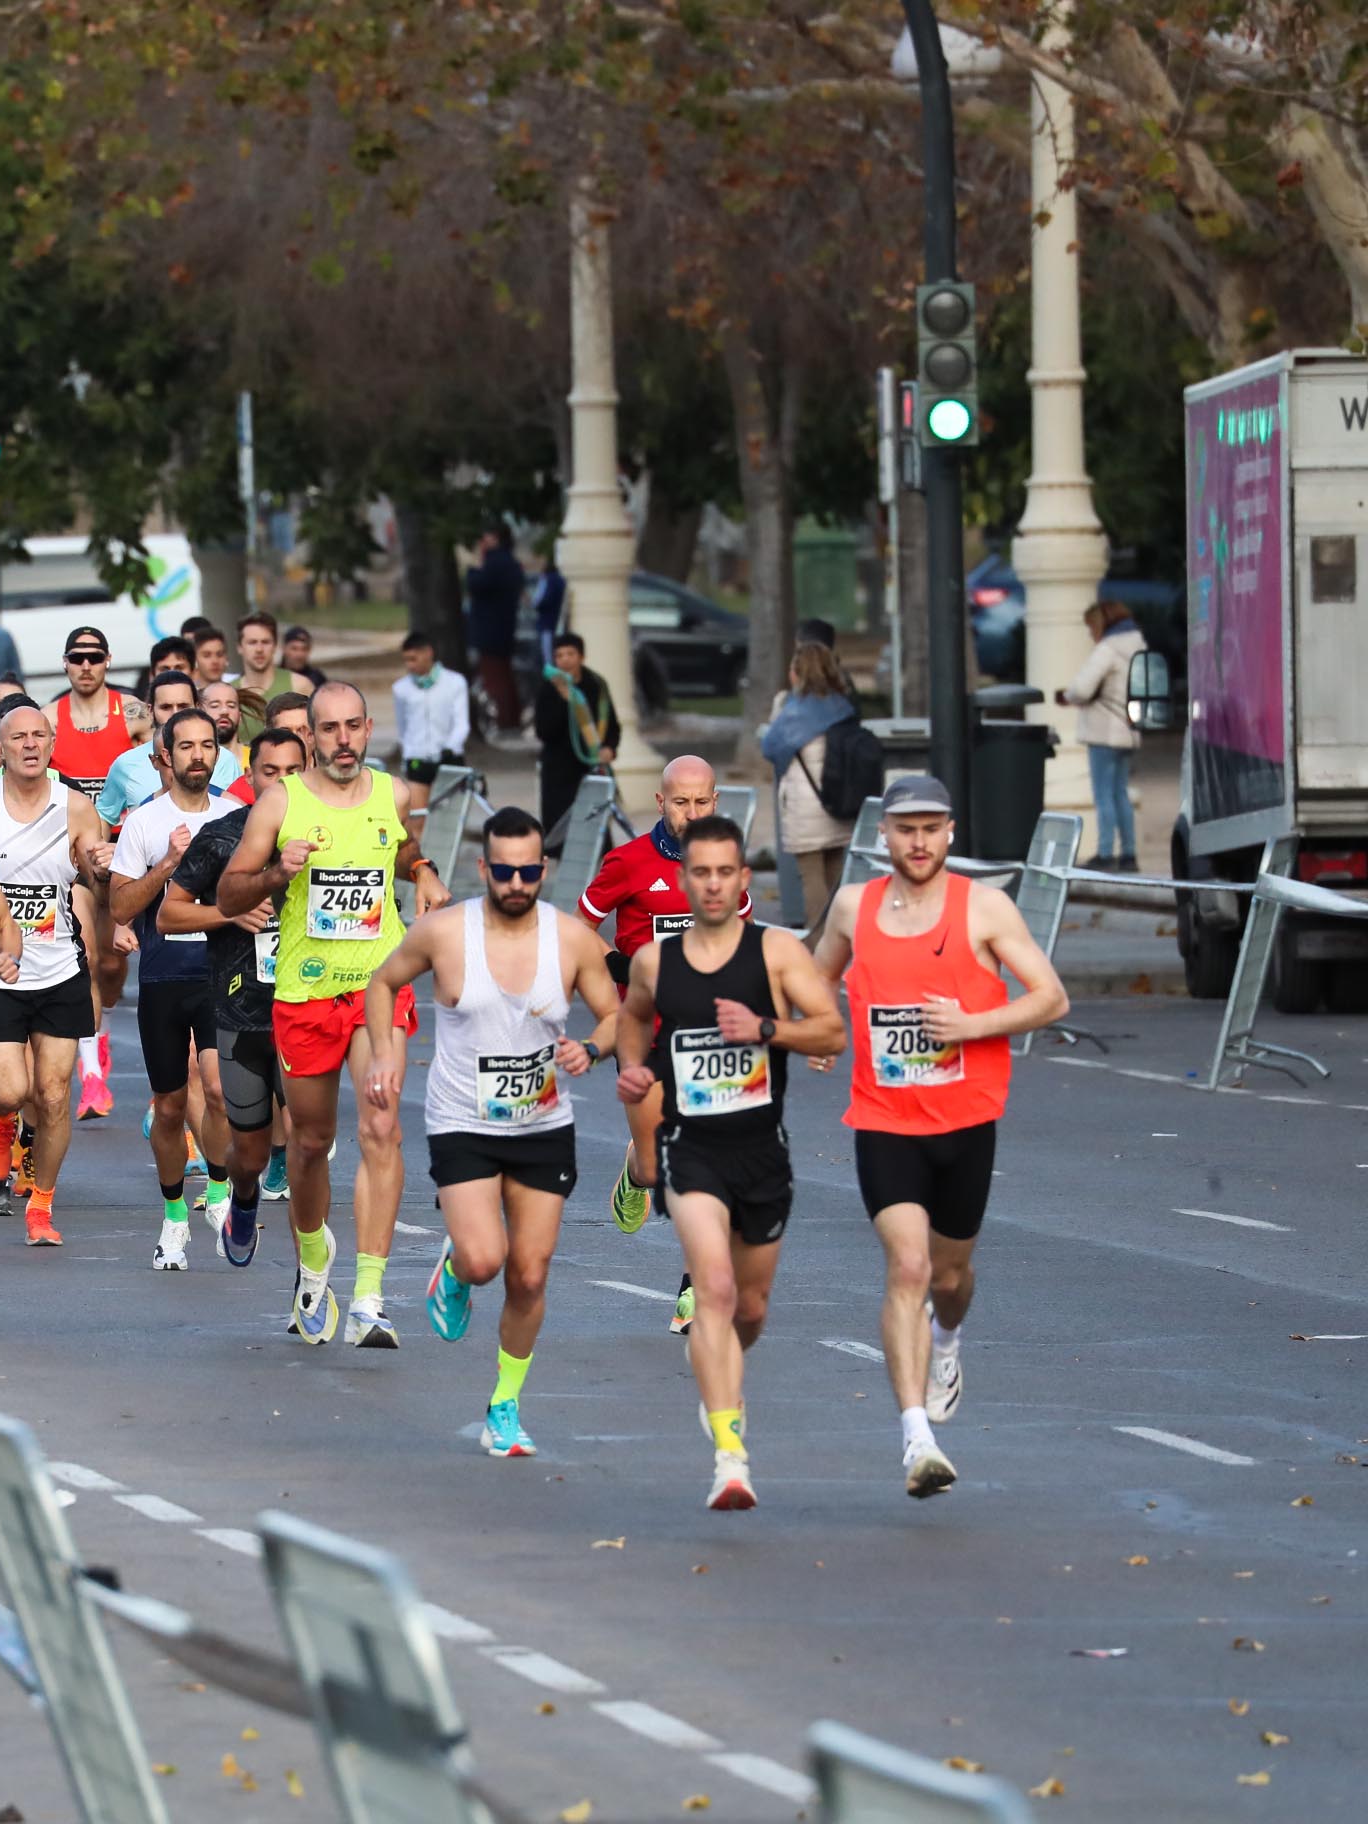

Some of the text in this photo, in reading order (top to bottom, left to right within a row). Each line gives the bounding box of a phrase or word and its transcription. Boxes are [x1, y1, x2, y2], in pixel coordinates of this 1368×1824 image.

[319, 872, 359, 883] iberCaja
[321, 888, 373, 912] 2464
[692, 1050, 753, 1081] 2096
[494, 1066, 545, 1098] 2576
